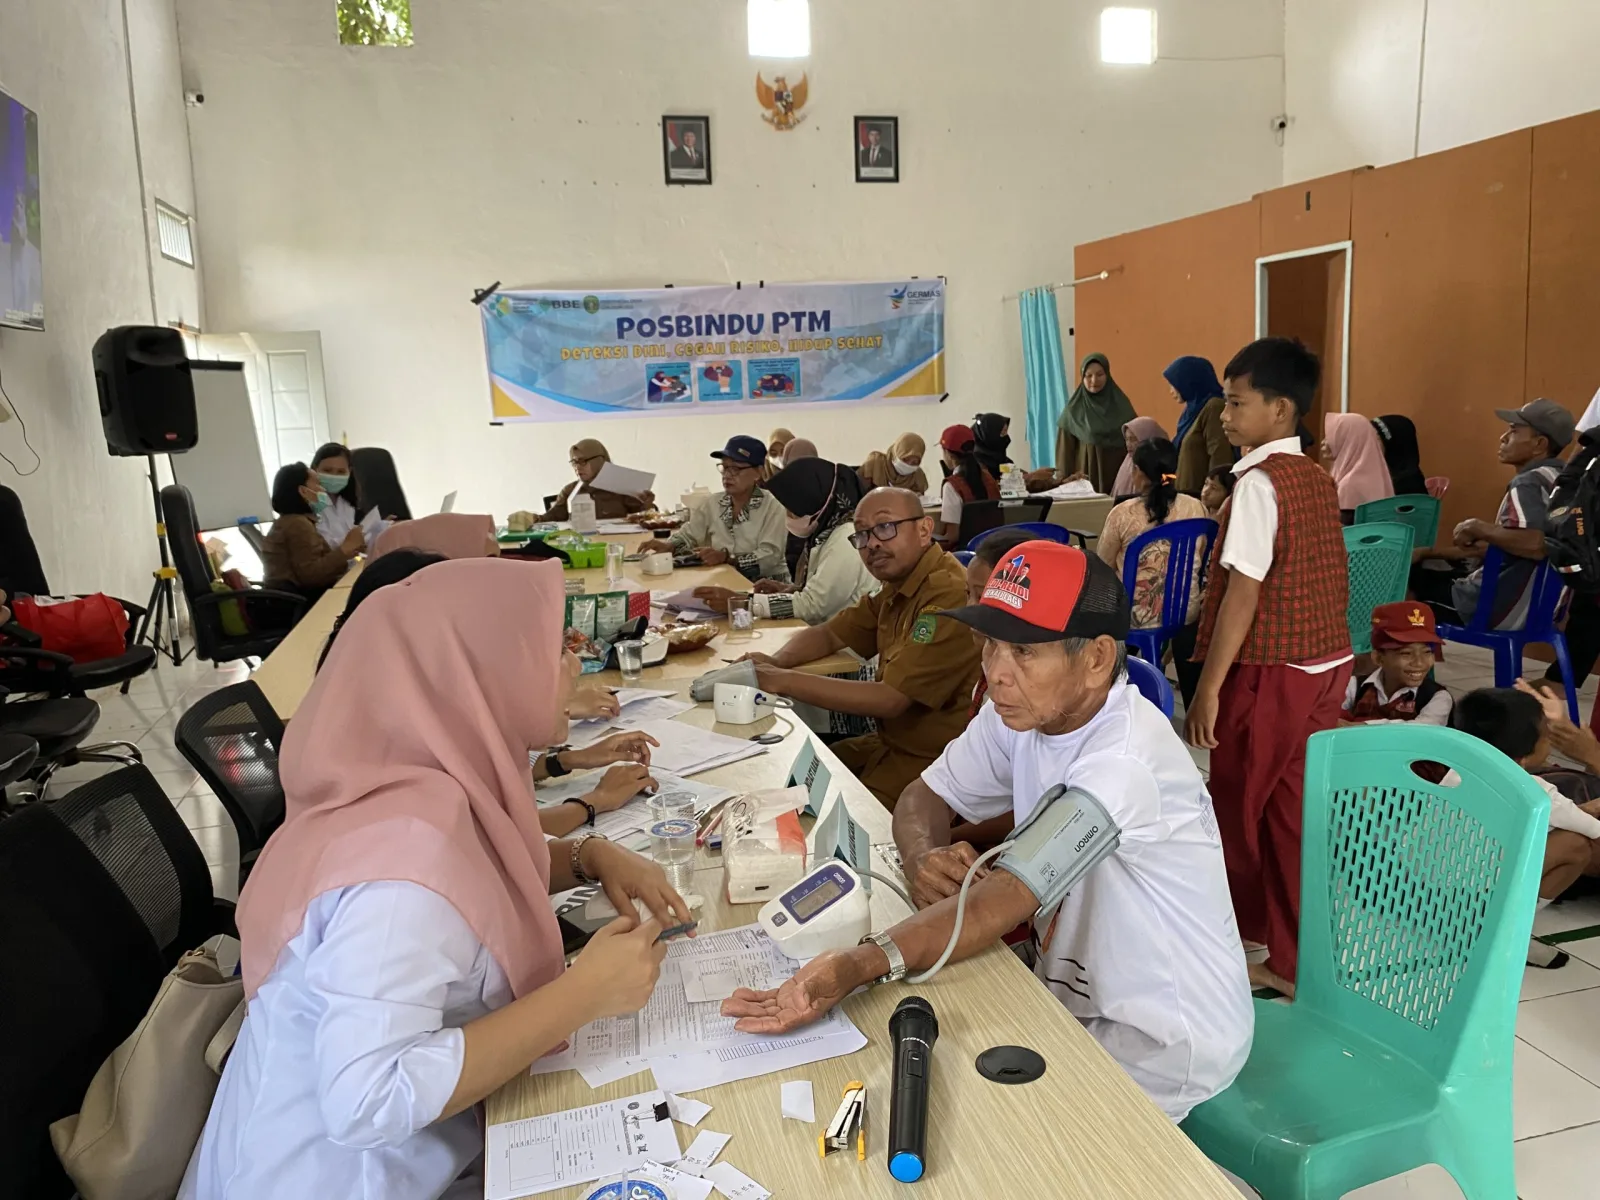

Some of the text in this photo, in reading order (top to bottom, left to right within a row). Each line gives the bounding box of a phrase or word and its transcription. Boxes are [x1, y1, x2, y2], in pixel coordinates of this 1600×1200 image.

[906, 290, 941, 299] GERMAS
[551, 299, 581, 310] BBE
[616, 309, 831, 339] POSBINDU PTM
